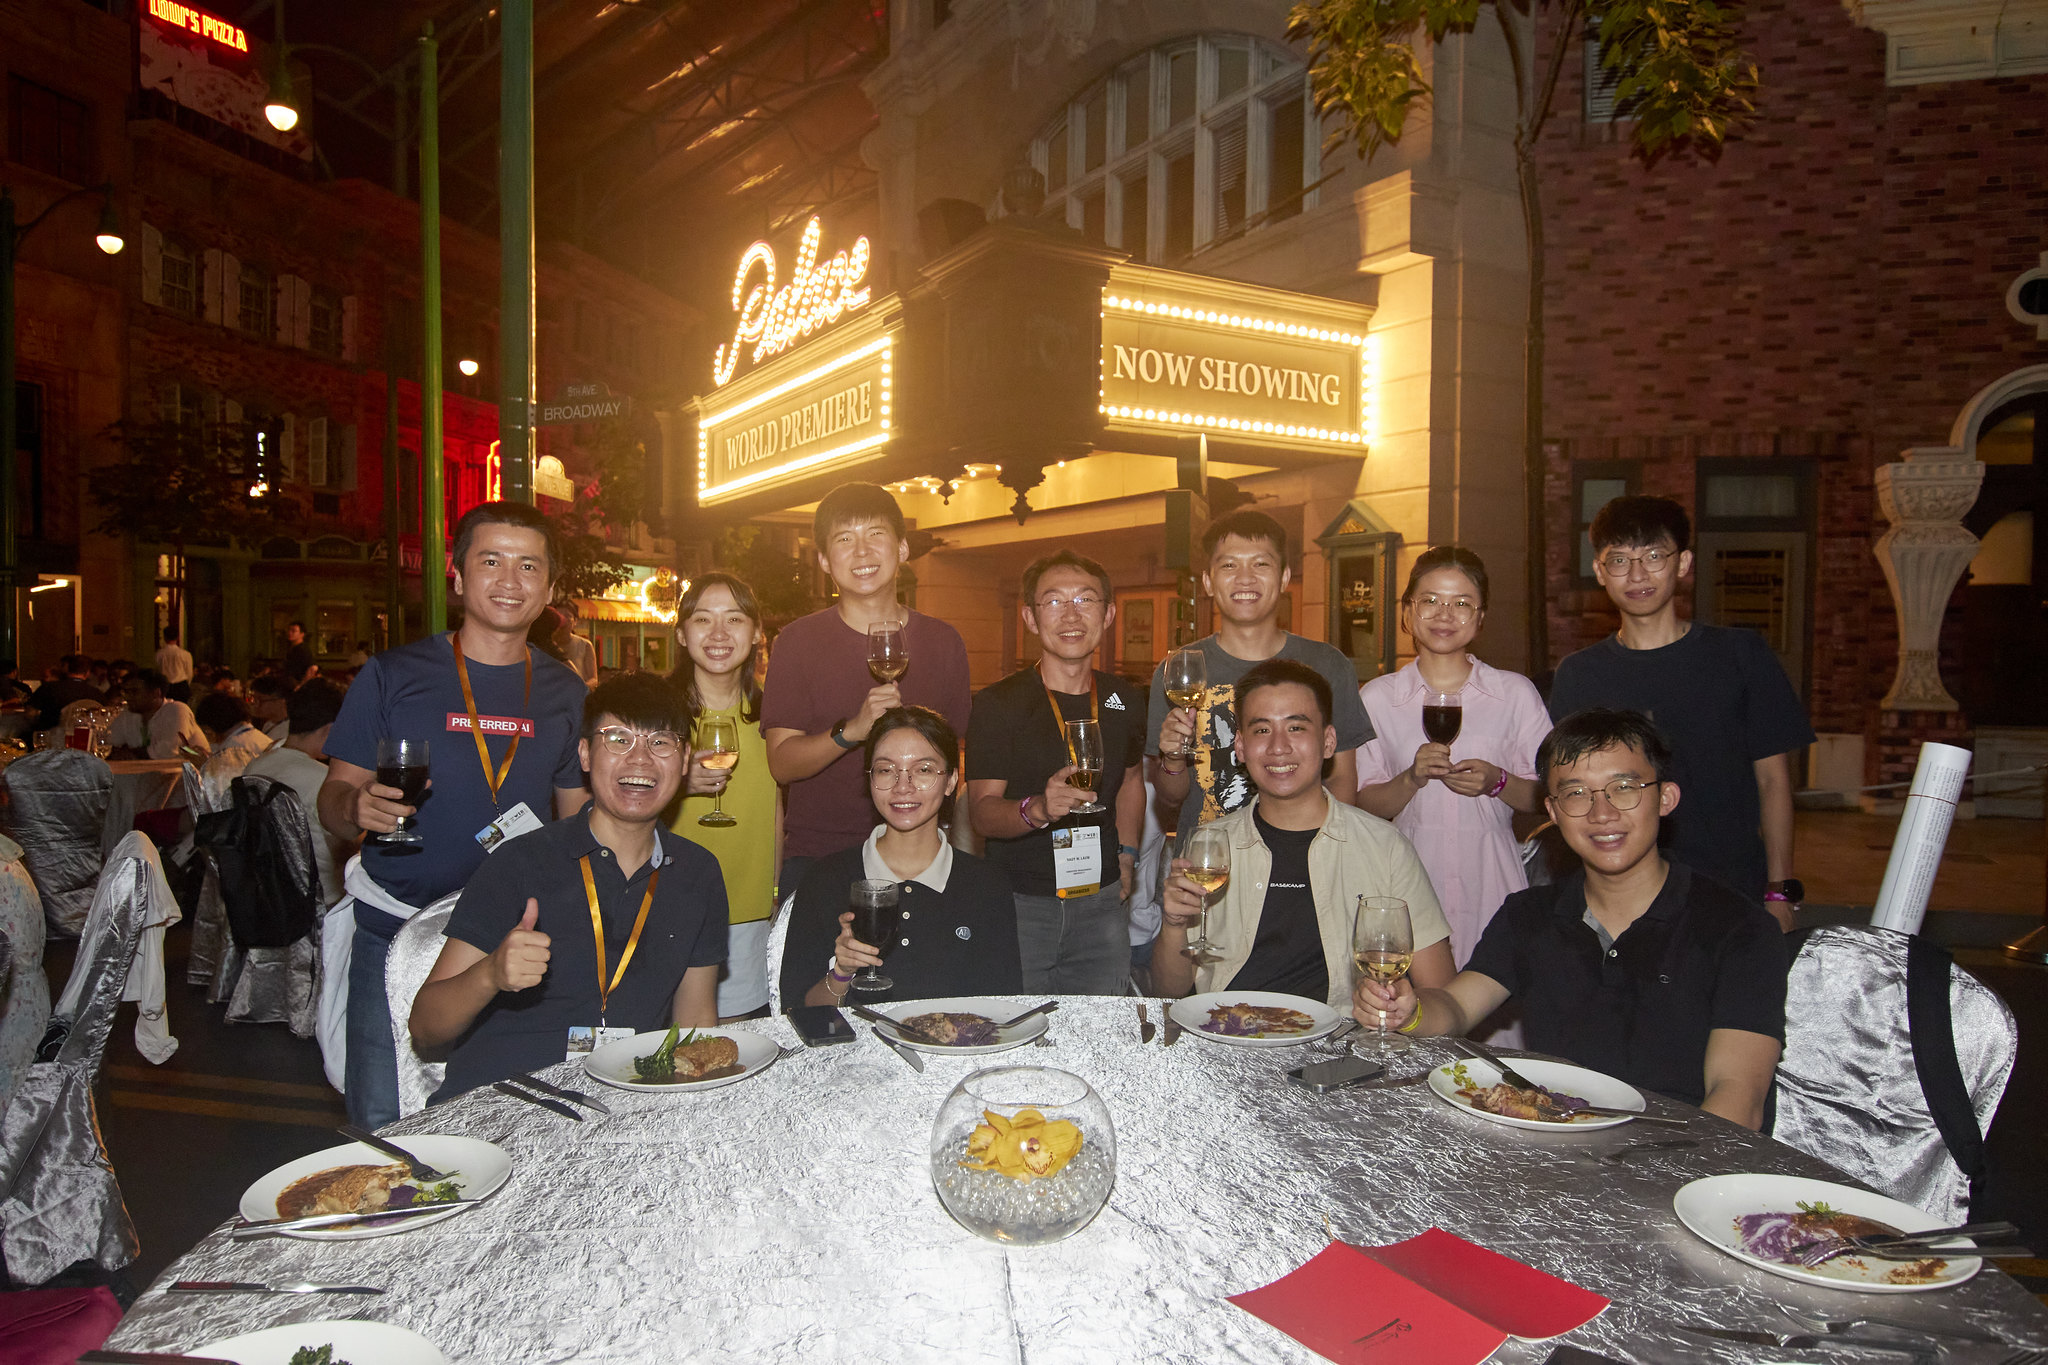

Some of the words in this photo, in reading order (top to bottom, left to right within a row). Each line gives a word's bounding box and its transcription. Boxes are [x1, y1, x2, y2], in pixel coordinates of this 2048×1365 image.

[202, 14, 248, 53] PIZZA
[1112, 344, 1196, 387] NOW
[1199, 356, 1341, 406] SHOWING
[544, 402, 622, 421] BROADWAY
[726, 420, 779, 470] WORLD
[780, 380, 872, 452] PREMIERE
[1104, 702, 1126, 711] adidas
[451, 717, 530, 733] PREERRED.AI
